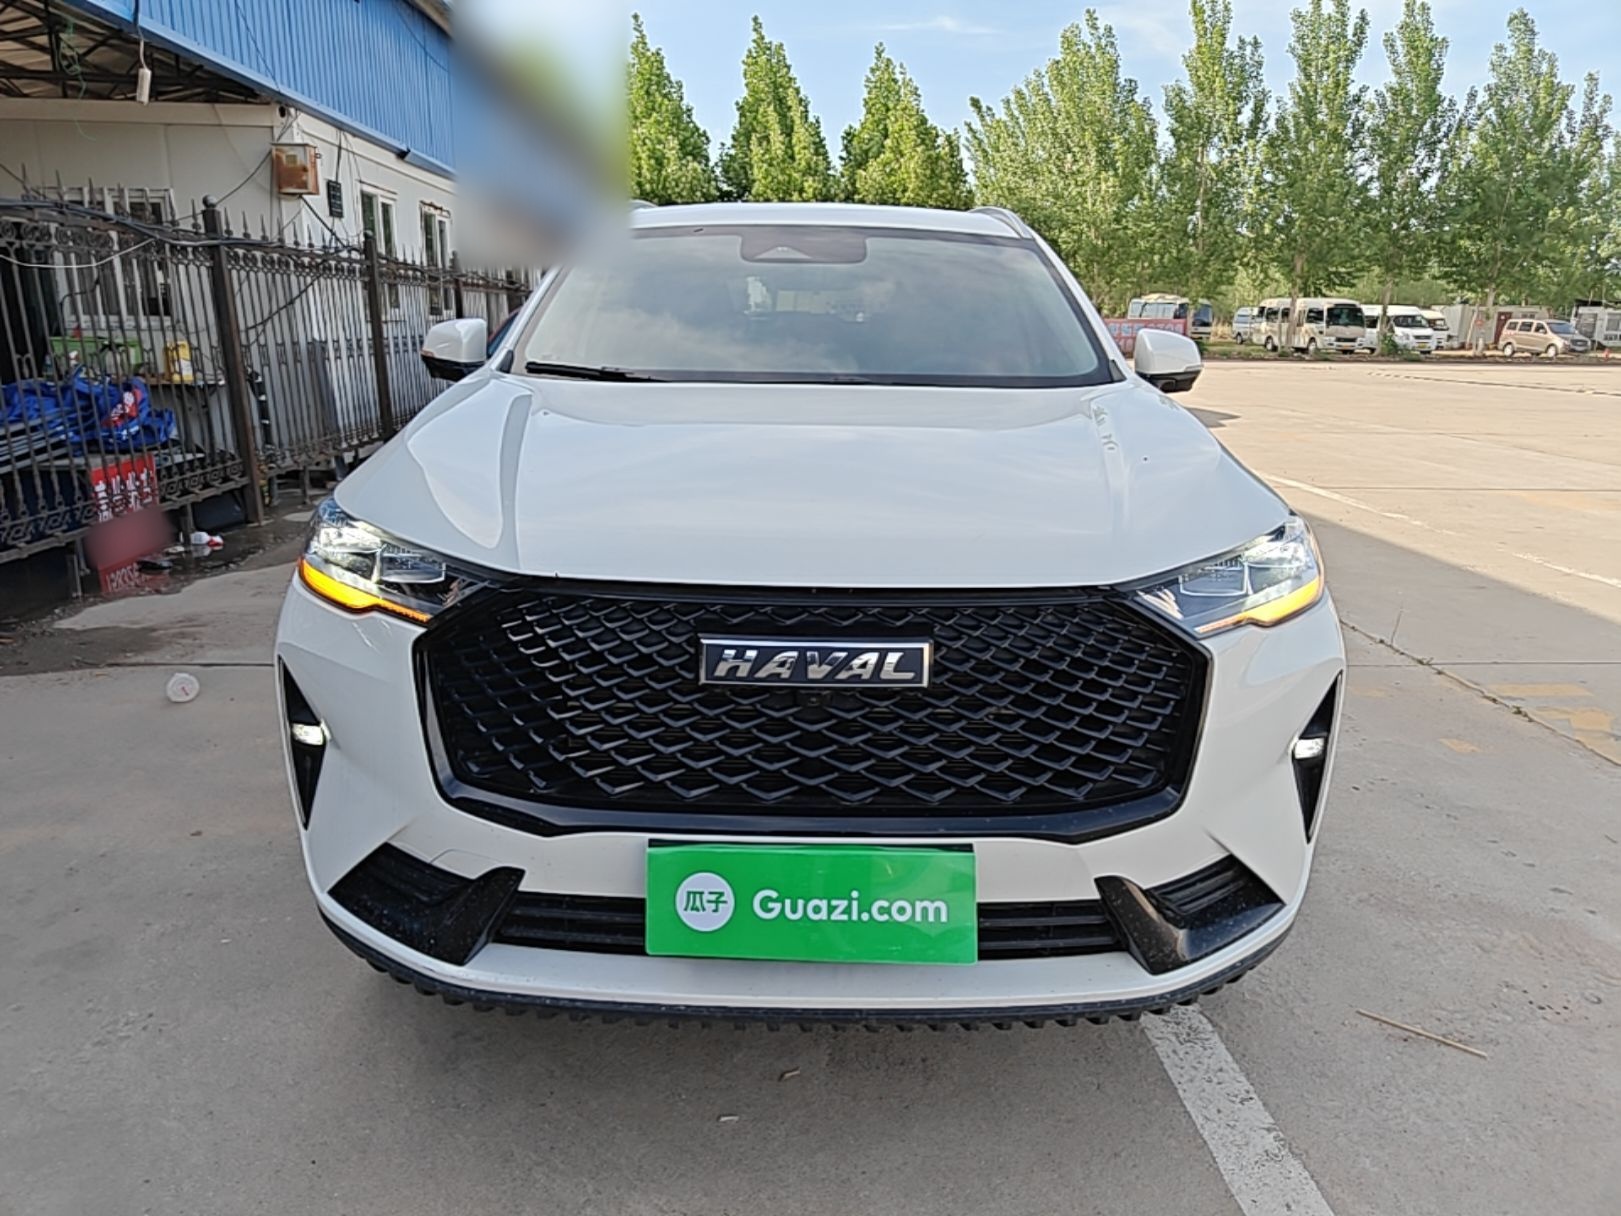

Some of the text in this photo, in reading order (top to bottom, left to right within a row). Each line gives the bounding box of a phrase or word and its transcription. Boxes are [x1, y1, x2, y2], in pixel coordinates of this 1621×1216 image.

[714, 649, 915, 680] HAVAL
[683, 890, 728, 914] 瓜子
[752, 888, 949, 923] Guazi.com
